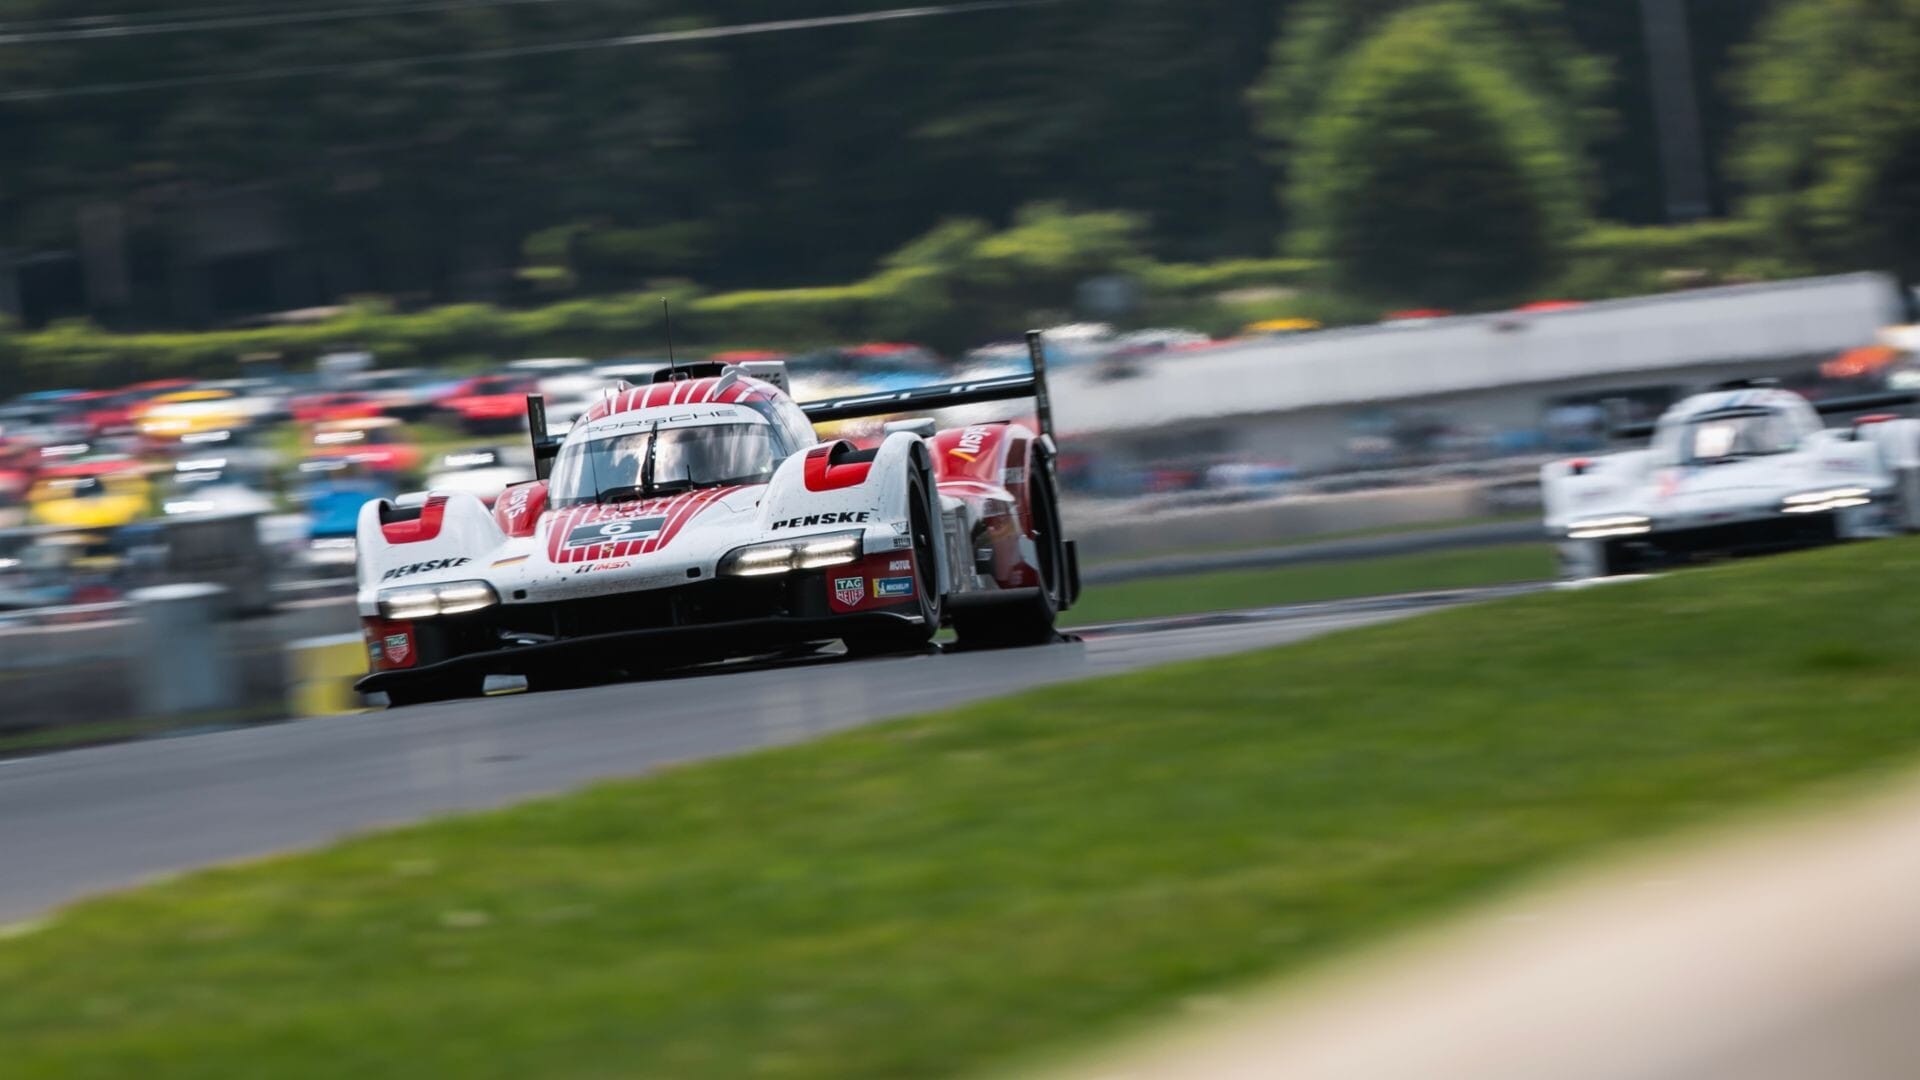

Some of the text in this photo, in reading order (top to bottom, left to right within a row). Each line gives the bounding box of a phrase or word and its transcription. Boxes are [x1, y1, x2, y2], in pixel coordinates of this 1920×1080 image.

[586, 410, 737, 432] PORSCHE
[600, 521, 634, 536] 6
[772, 512, 869, 530] PENSKE
[382, 557, 472, 580] PENSKE
[838, 580, 861, 590] TAG
